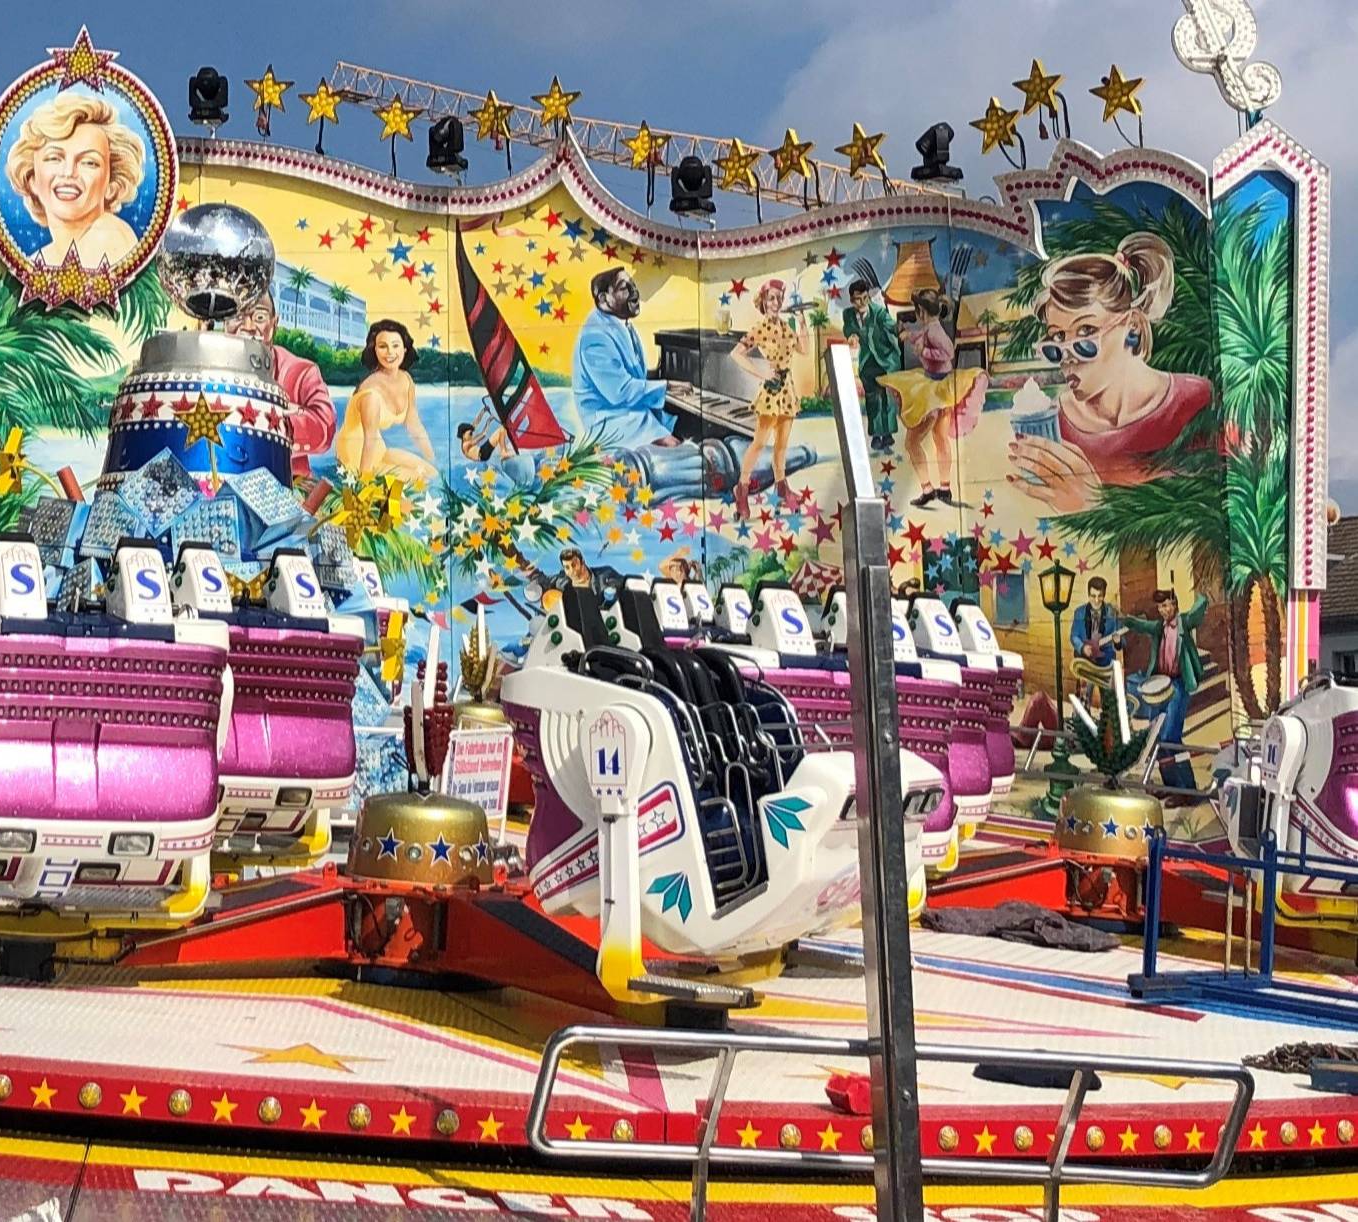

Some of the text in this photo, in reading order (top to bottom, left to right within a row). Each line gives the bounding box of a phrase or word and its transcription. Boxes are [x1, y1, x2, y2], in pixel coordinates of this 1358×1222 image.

[10, 563, 35, 595] S
[136, 568, 161, 599] S
[201, 567, 222, 593] S
[295, 573, 316, 598] S
[666, 596, 681, 615] S
[781, 607, 804, 634] S
[934, 614, 953, 637] S
[976, 620, 992, 641] S
[595, 747, 622, 775] 14
[133, 1168, 655, 1221] DANGER
